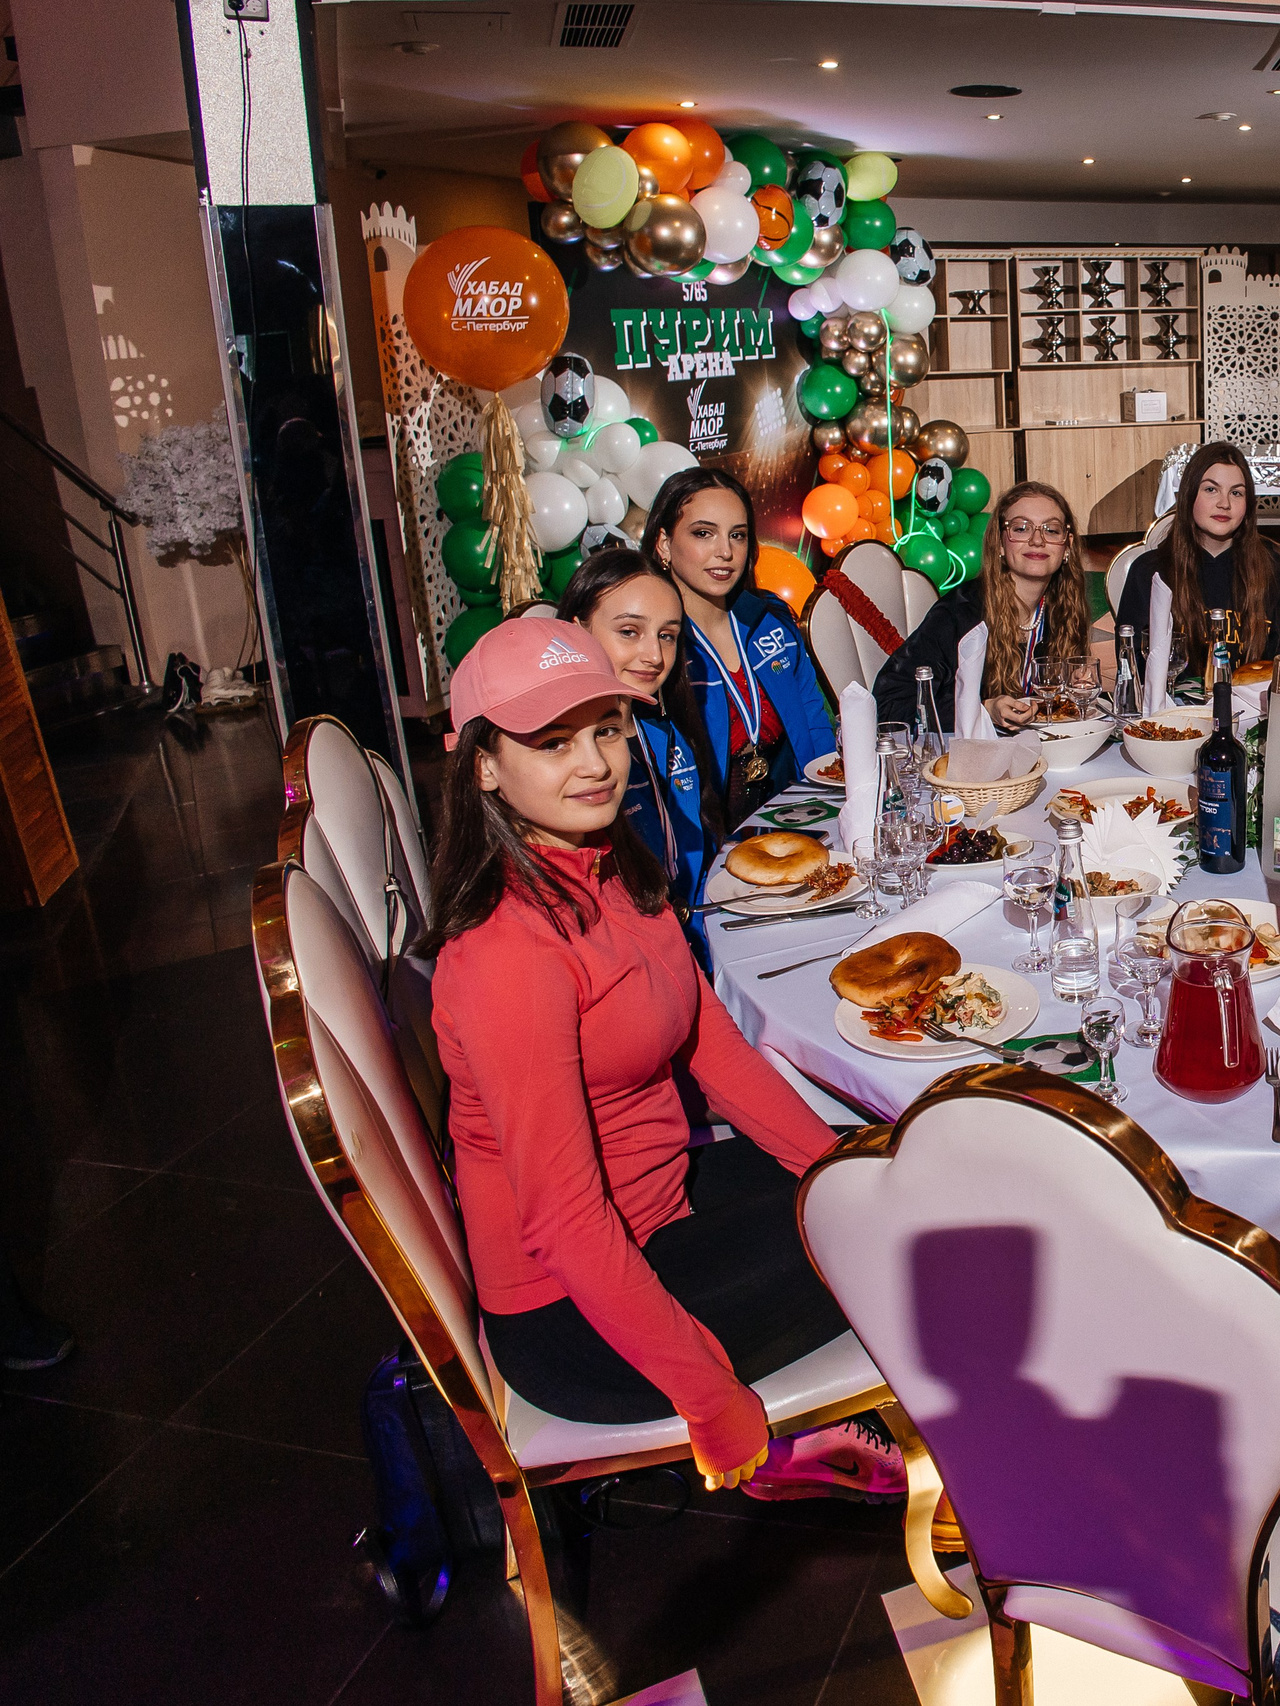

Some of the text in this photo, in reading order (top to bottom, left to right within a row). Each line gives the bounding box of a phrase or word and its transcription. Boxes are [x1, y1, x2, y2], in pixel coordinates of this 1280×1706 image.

[463, 280, 523, 296] ХАБАД
[452, 297, 523, 317] МАОР
[451, 320, 529, 333] С.-Петербург
[610, 308, 776, 370] ПУРИМ
[667, 351, 736, 382] АРЕНА
[697, 402, 725, 419] ХАБАД
[689, 416, 724, 438] МАОР
[539, 652, 589, 669] adidas
